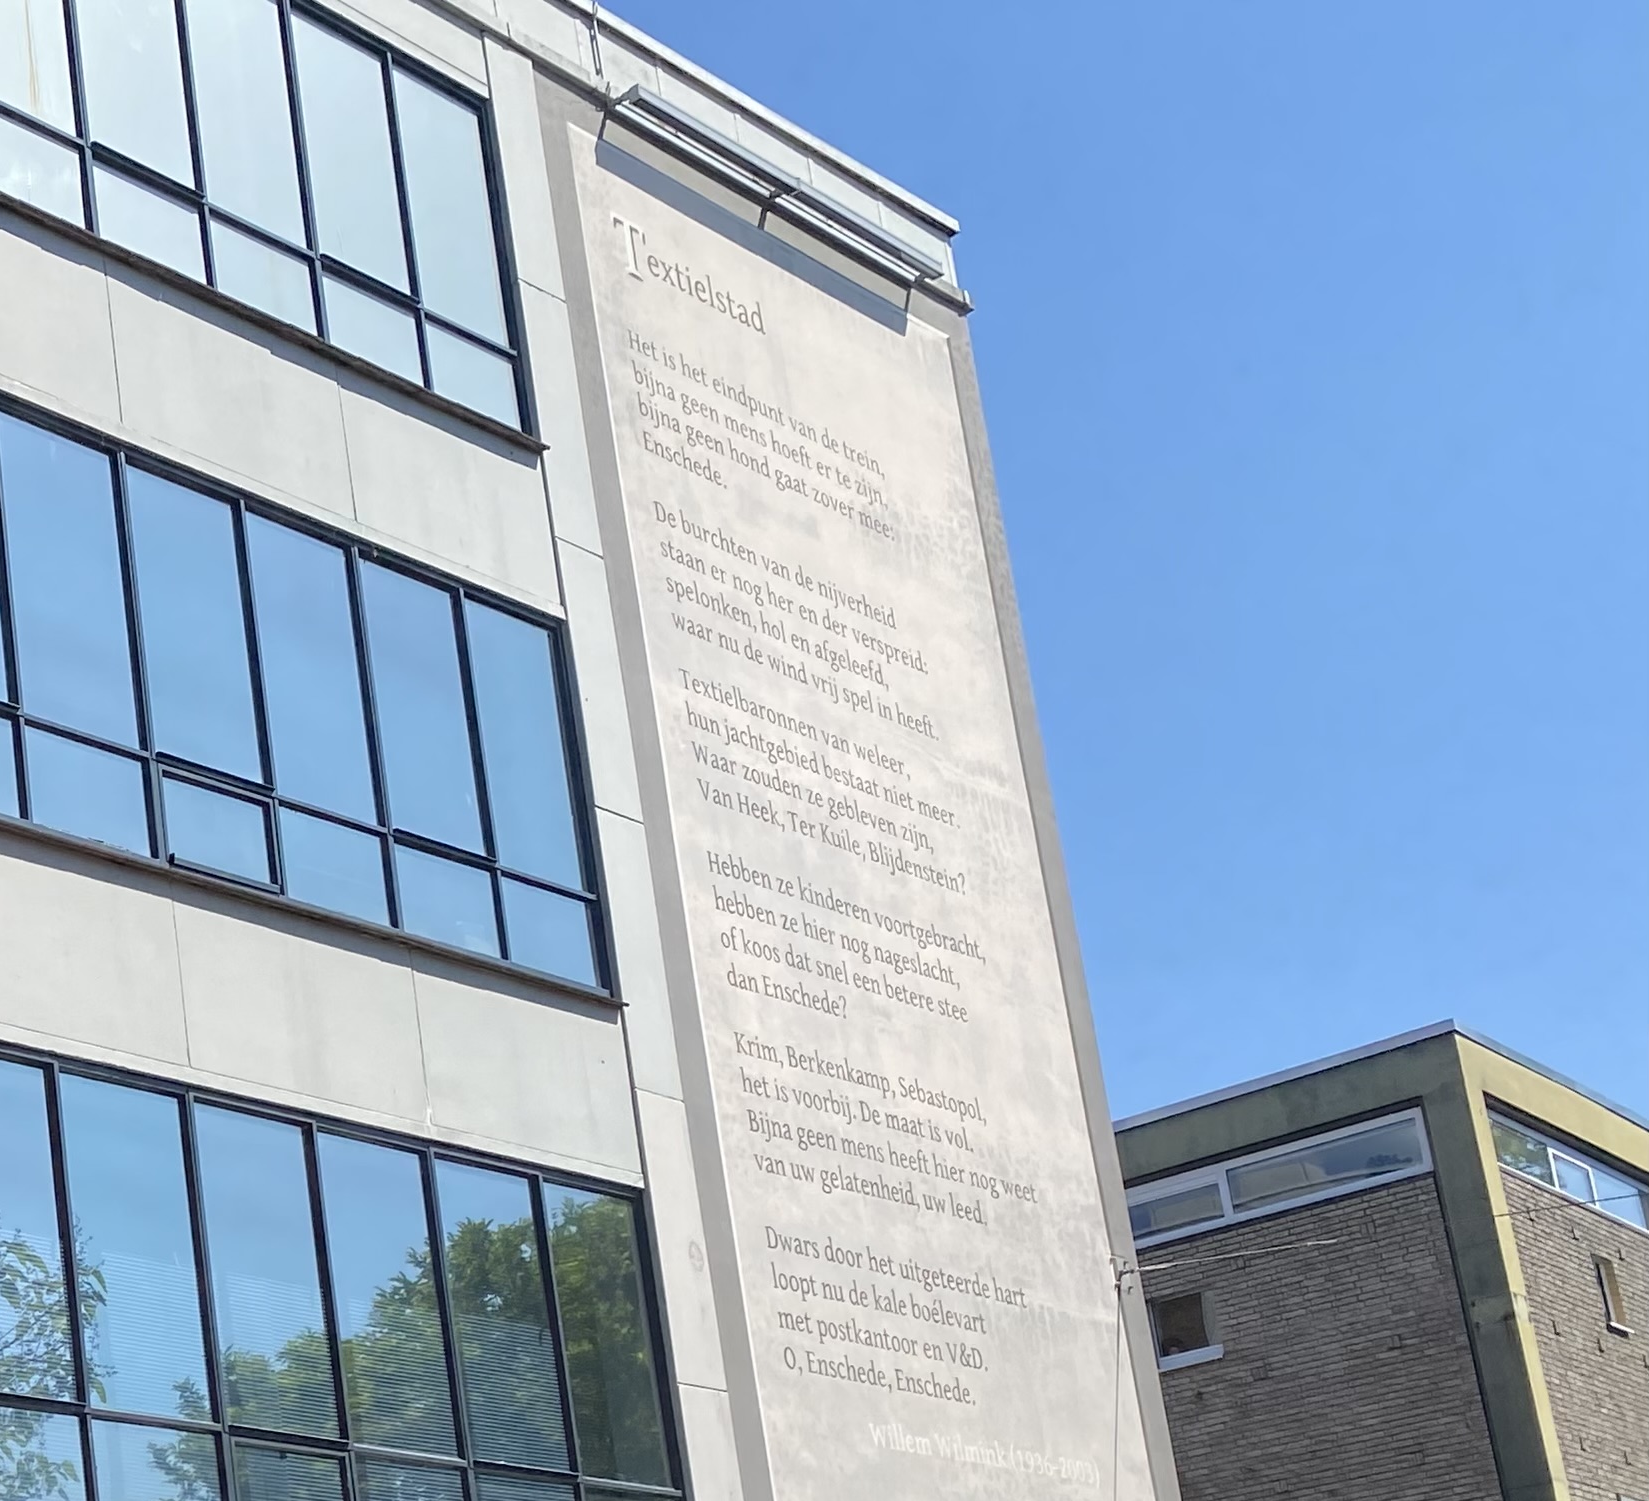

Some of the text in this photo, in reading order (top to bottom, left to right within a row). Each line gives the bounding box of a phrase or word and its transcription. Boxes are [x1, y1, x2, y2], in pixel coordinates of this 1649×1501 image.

[611, 214, 767, 336] Textielstad
[628, 329, 885, 480] Het is het eindpunt van de trein,
[631, 359, 888, 510] bijna geen mens hoeft er te zijn,
[637, 391, 895, 541] bijna geen hond gaat zover mee:
[643, 430, 727, 489] Enschede.
[653, 500, 897, 630] De burchten van de nijverheid
[660, 540, 706, 575] staan
[711, 565, 727, 584] er
[732, 574, 764, 607] nog
[765, 581, 794, 614] her
[799, 605, 818, 625] en
[822, 608, 847, 638] der
[666, 577, 889, 692] spelonken, hol en afgeleefd,
[671, 613, 939, 741] waar nu de wind vrij spel in heeft.
[678, 668, 911, 781] Textielbaronnen van weleer,
[685, 700, 960, 829] hun jachtgebied bestaat niet meer.
[691, 741, 934, 855] Waar zouden ze gebleven zijn,
[696, 778, 965, 895] Van Heek, Ter Kuile, Blijdenstein?
[706, 850, 986, 965] Hebben ze kinderen voortgebracht,
[712, 884, 960, 991] hebben ze hier nog nageslacht,
[720, 926, 969, 1023] of koos dat snel een betere stee
[727, 962, 847, 1019] dan Enschede?
[733, 1031, 987, 1126] Krim, Berkenkamp, Sebastopol,
[739, 1066, 974, 1153] het is voorbij. De maat is vol.
[746, 1109, 1038, 1204] Bijna geen mens heeft hier nog weet
[753, 1154, 988, 1226] van uw gelatenheid, uw leed.
[764, 1226, 1027, 1309] Dwars door het uitgeteerde hart
[770, 1261, 987, 1335] loopt nu de kale boélevart
[777, 1311, 988, 1372] met postkantoor en V&D.
[783, 1346, 976, 1406] O, Enschede, Enschede.
[869, 1422, 1100, 1489] Willem Wilmink (1936-2003)
